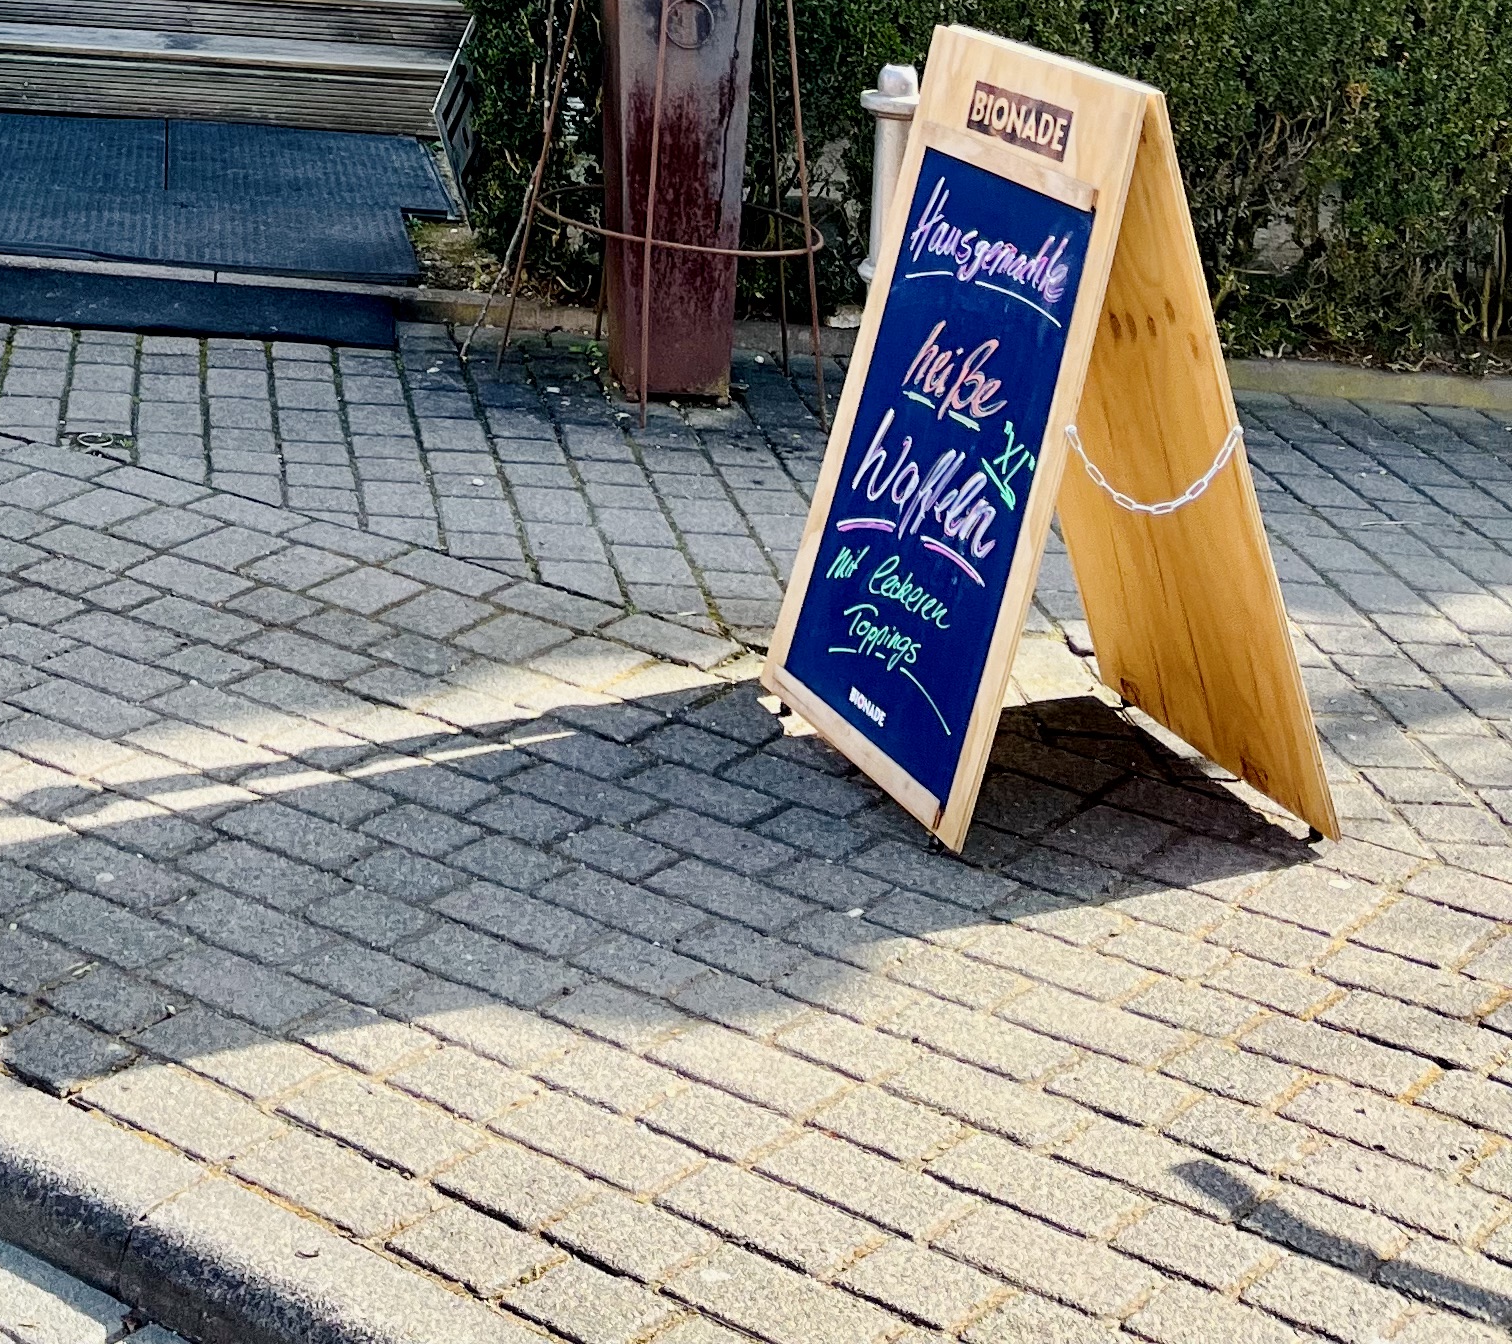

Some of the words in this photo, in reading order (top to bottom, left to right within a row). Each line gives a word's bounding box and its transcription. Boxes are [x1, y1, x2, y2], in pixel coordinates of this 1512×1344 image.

[970, 90, 1068, 152] BIONADE
[902, 319, 1008, 420] heiße
[852, 408, 996, 559] Waffeln
[868, 555, 951, 630] leckeren
[843, 603, 922, 671] Toppings
[848, 685, 887, 728] BIONADE
